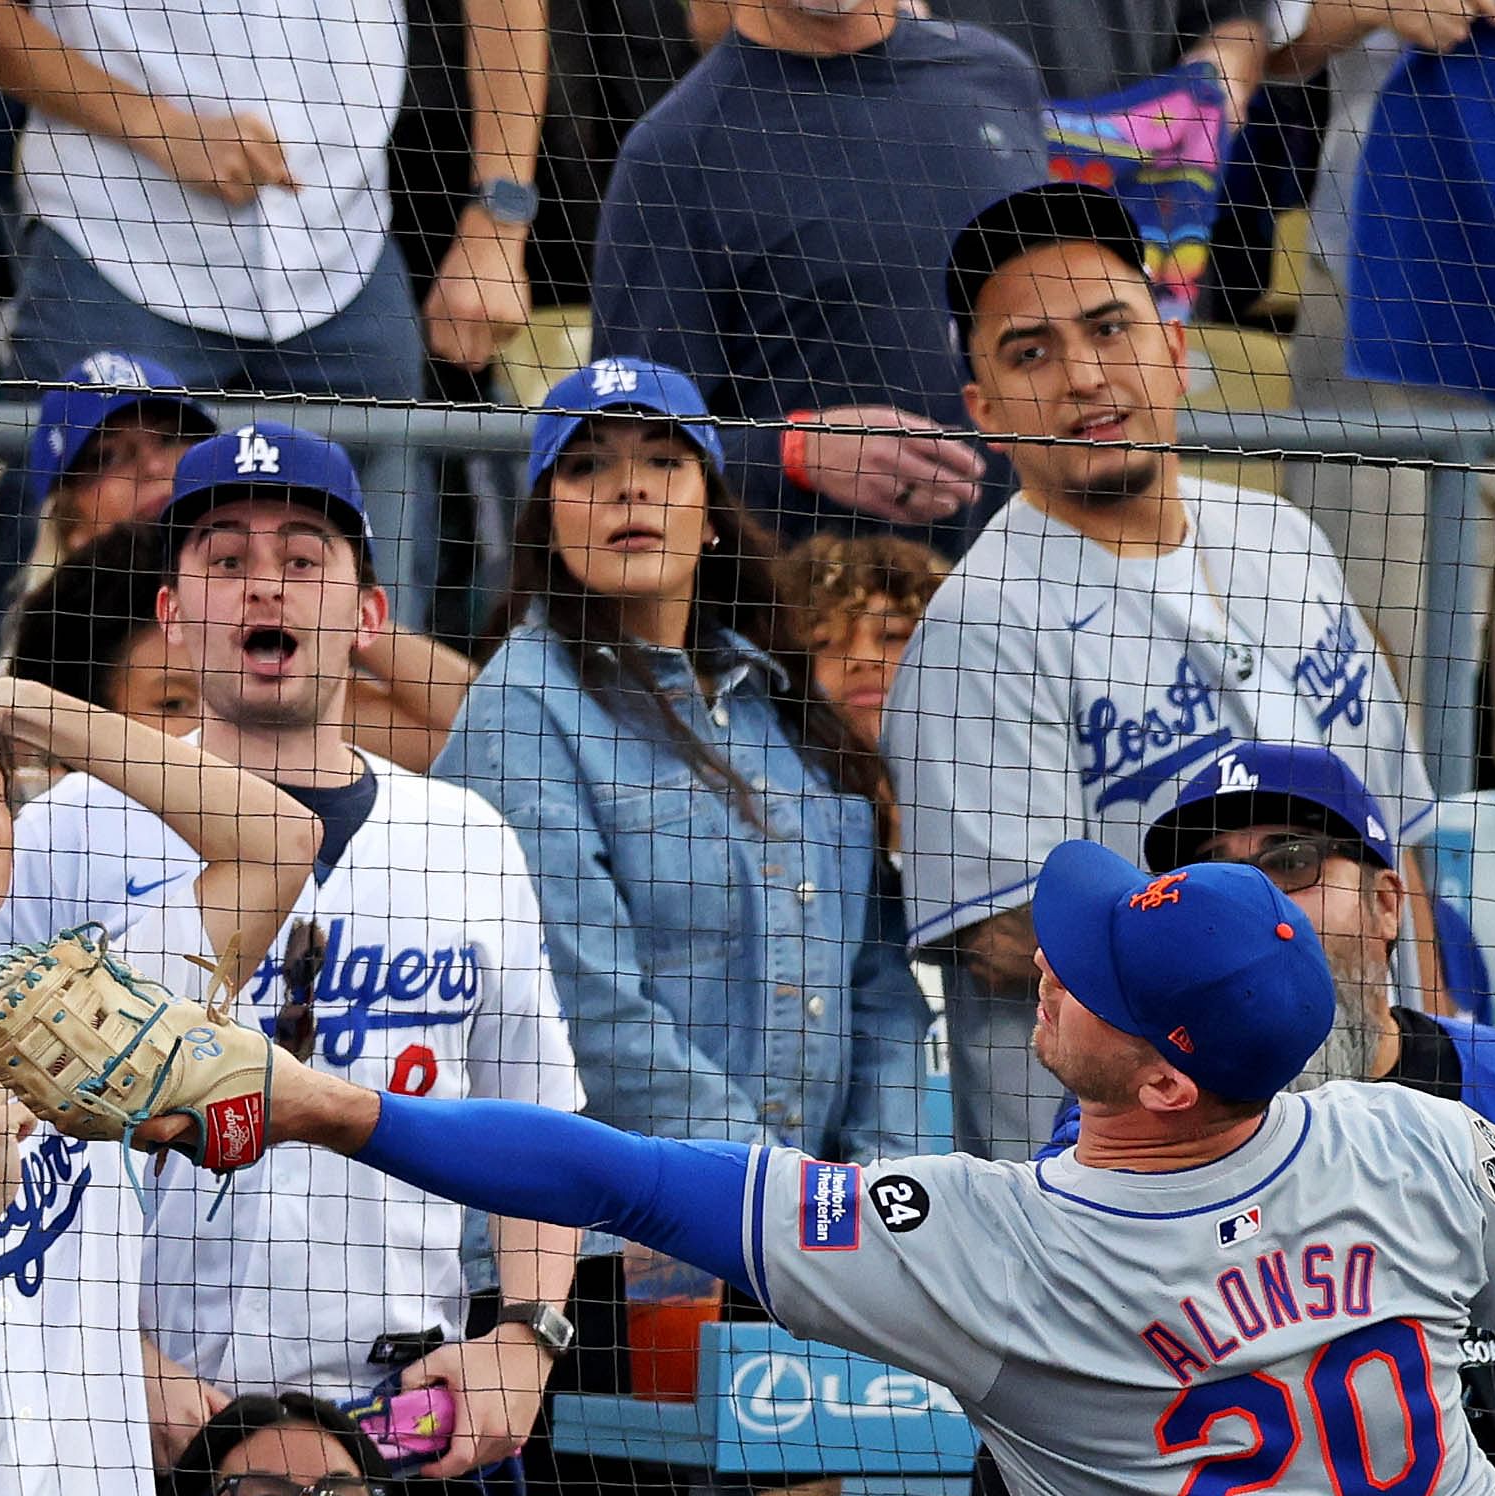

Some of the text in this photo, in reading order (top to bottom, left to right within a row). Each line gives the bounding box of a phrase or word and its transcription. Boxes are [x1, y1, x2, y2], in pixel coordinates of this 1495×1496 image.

[590, 358, 638, 396] LA
[234, 425, 280, 474] LA
[1075, 697, 1173, 786] Los
[1217, 754, 1260, 794] LA
[185, 1026, 224, 1061] 20
[813, 1172, 833, 1241] Presbyterian
[876, 1183, 922, 1225] 24
[1139, 1243, 1377, 1388] ALONSO
